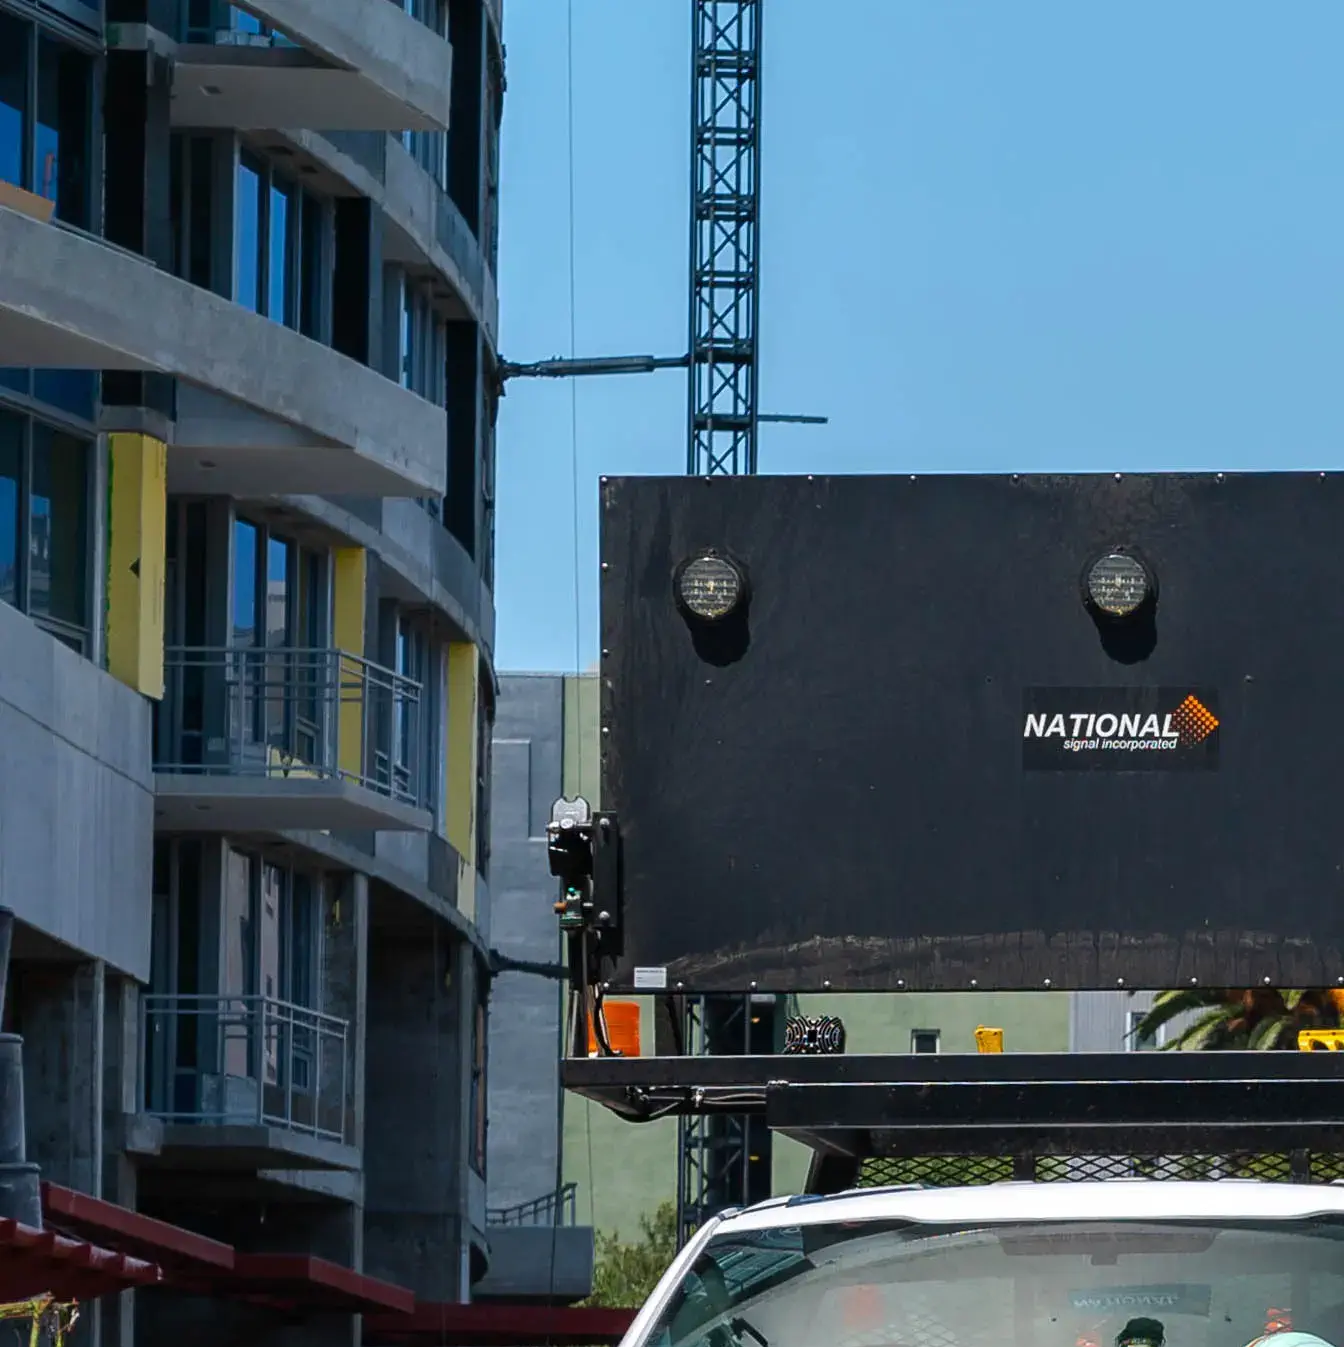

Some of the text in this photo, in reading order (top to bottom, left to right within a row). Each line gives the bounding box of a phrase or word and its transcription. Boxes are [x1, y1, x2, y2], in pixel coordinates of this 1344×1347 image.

[1023, 713, 1180, 737] NATIONAL
[1063, 738, 1178, 752] signal incorporated
